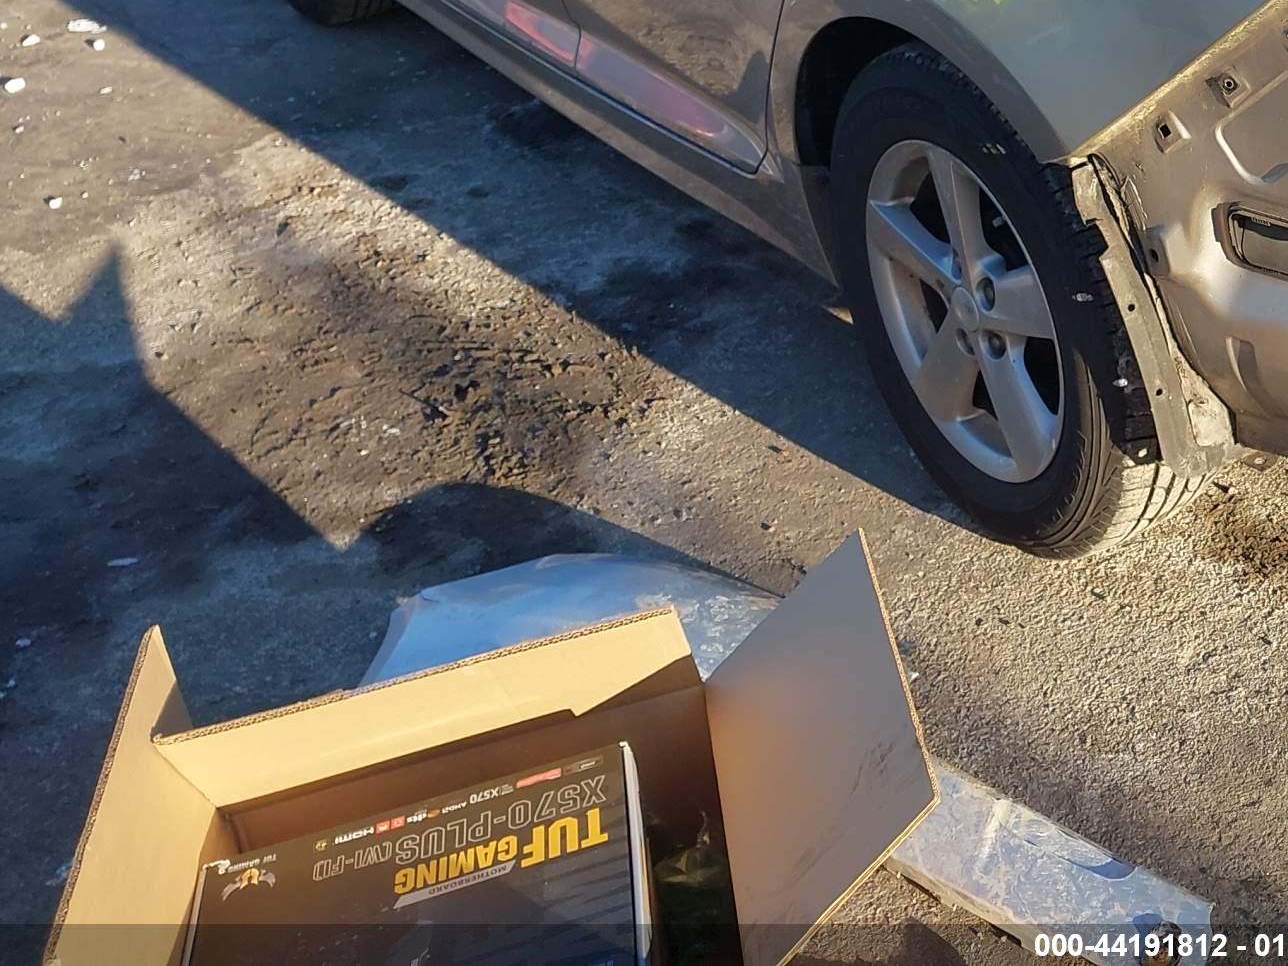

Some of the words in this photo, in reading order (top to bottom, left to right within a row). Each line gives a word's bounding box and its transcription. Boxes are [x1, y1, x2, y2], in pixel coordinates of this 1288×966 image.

[469, 785, 500, 804] X570
[334, 826, 374, 844] HDMI
[395, 774, 607, 865] X570-PLUS
[521, 808, 609, 868] TUF
[311, 840, 393, 882] (WI-FI)
[393, 835, 518, 895] GAMING
[428, 864, 507, 895] MOTHERBOARD
